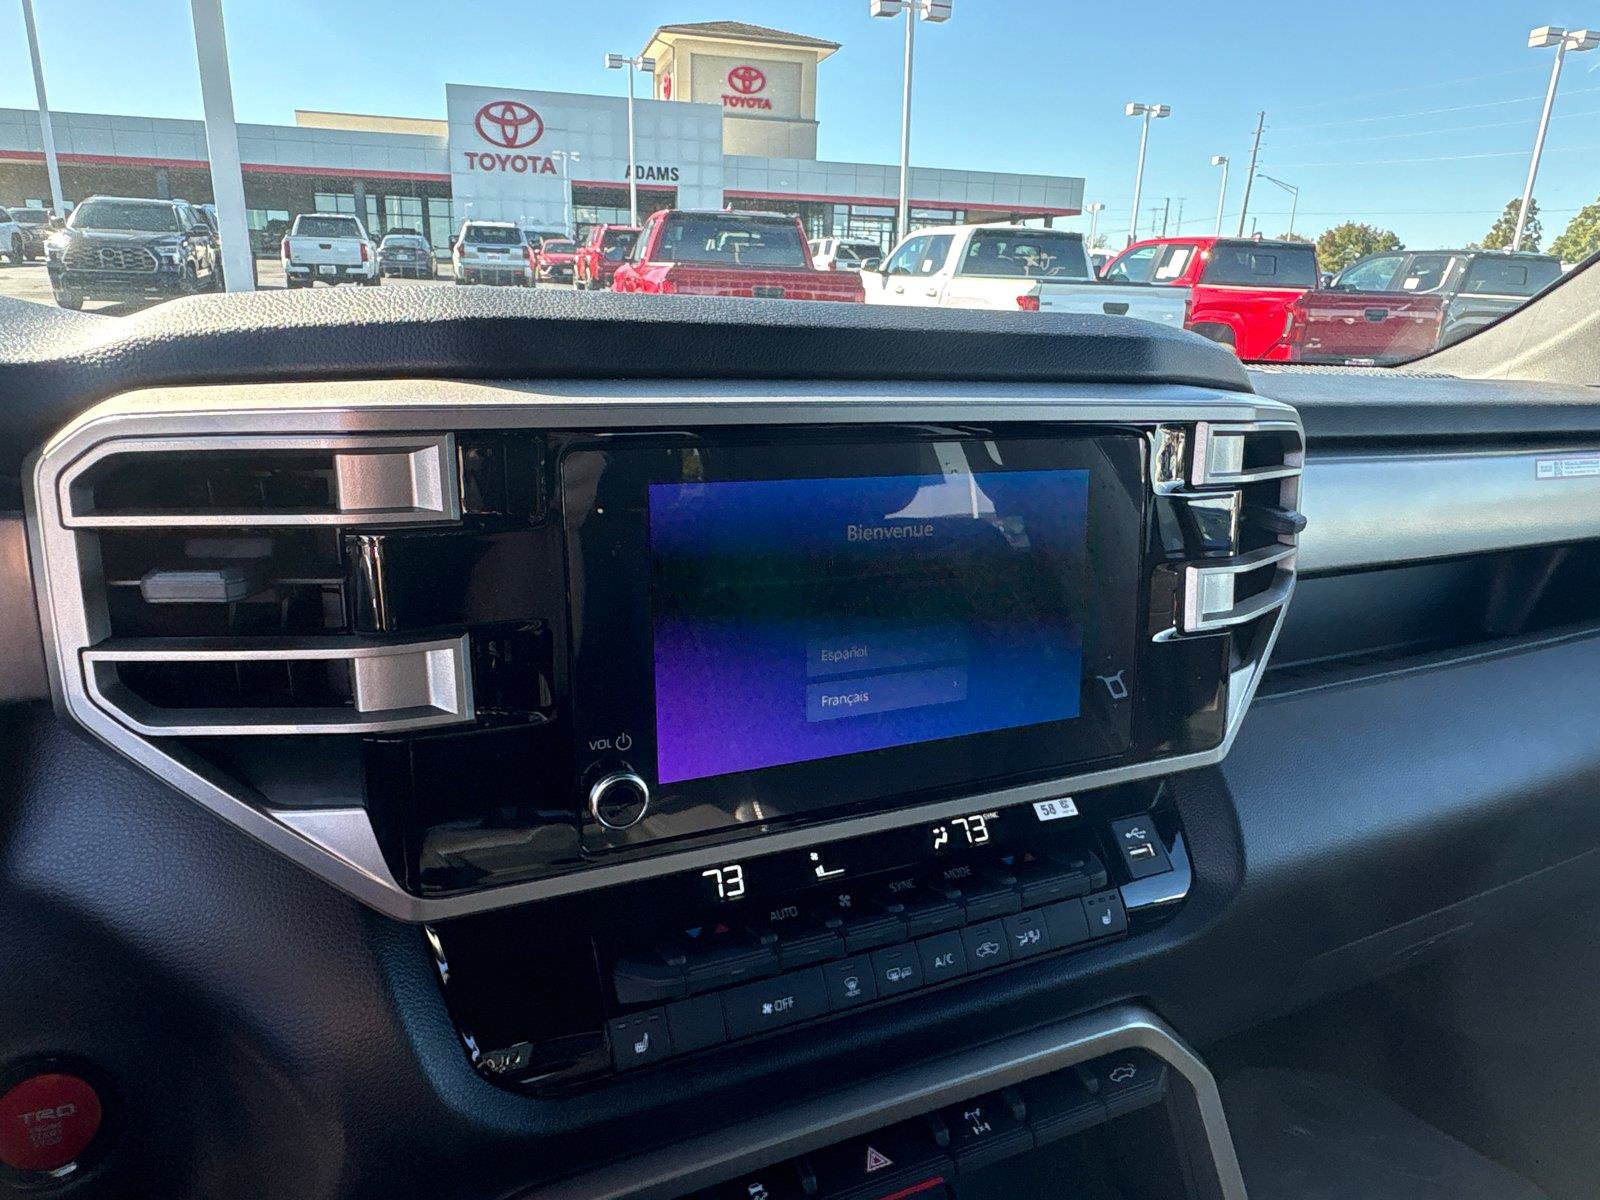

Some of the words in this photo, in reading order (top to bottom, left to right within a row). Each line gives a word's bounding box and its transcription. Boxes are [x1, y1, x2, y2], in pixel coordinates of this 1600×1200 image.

[721, 94, 772, 110] TOYOTA
[464, 151, 558, 175] TOYOTA
[847, 524, 934, 541] Bienvenue
[821, 646, 868, 662] Español
[821, 691, 869, 707] Français
[589, 739, 612, 750] VOL
[1040, 803, 1057, 816] 58
[951, 814, 989, 843] 73
[702, 864, 745, 897] 73
[943, 866, 971, 880] MODE
[889, 878, 916, 892] SYNC
[770, 906, 798, 921] AUTO
[935, 953, 954, 968] A/C
[774, 996, 794, 1011] OFF
